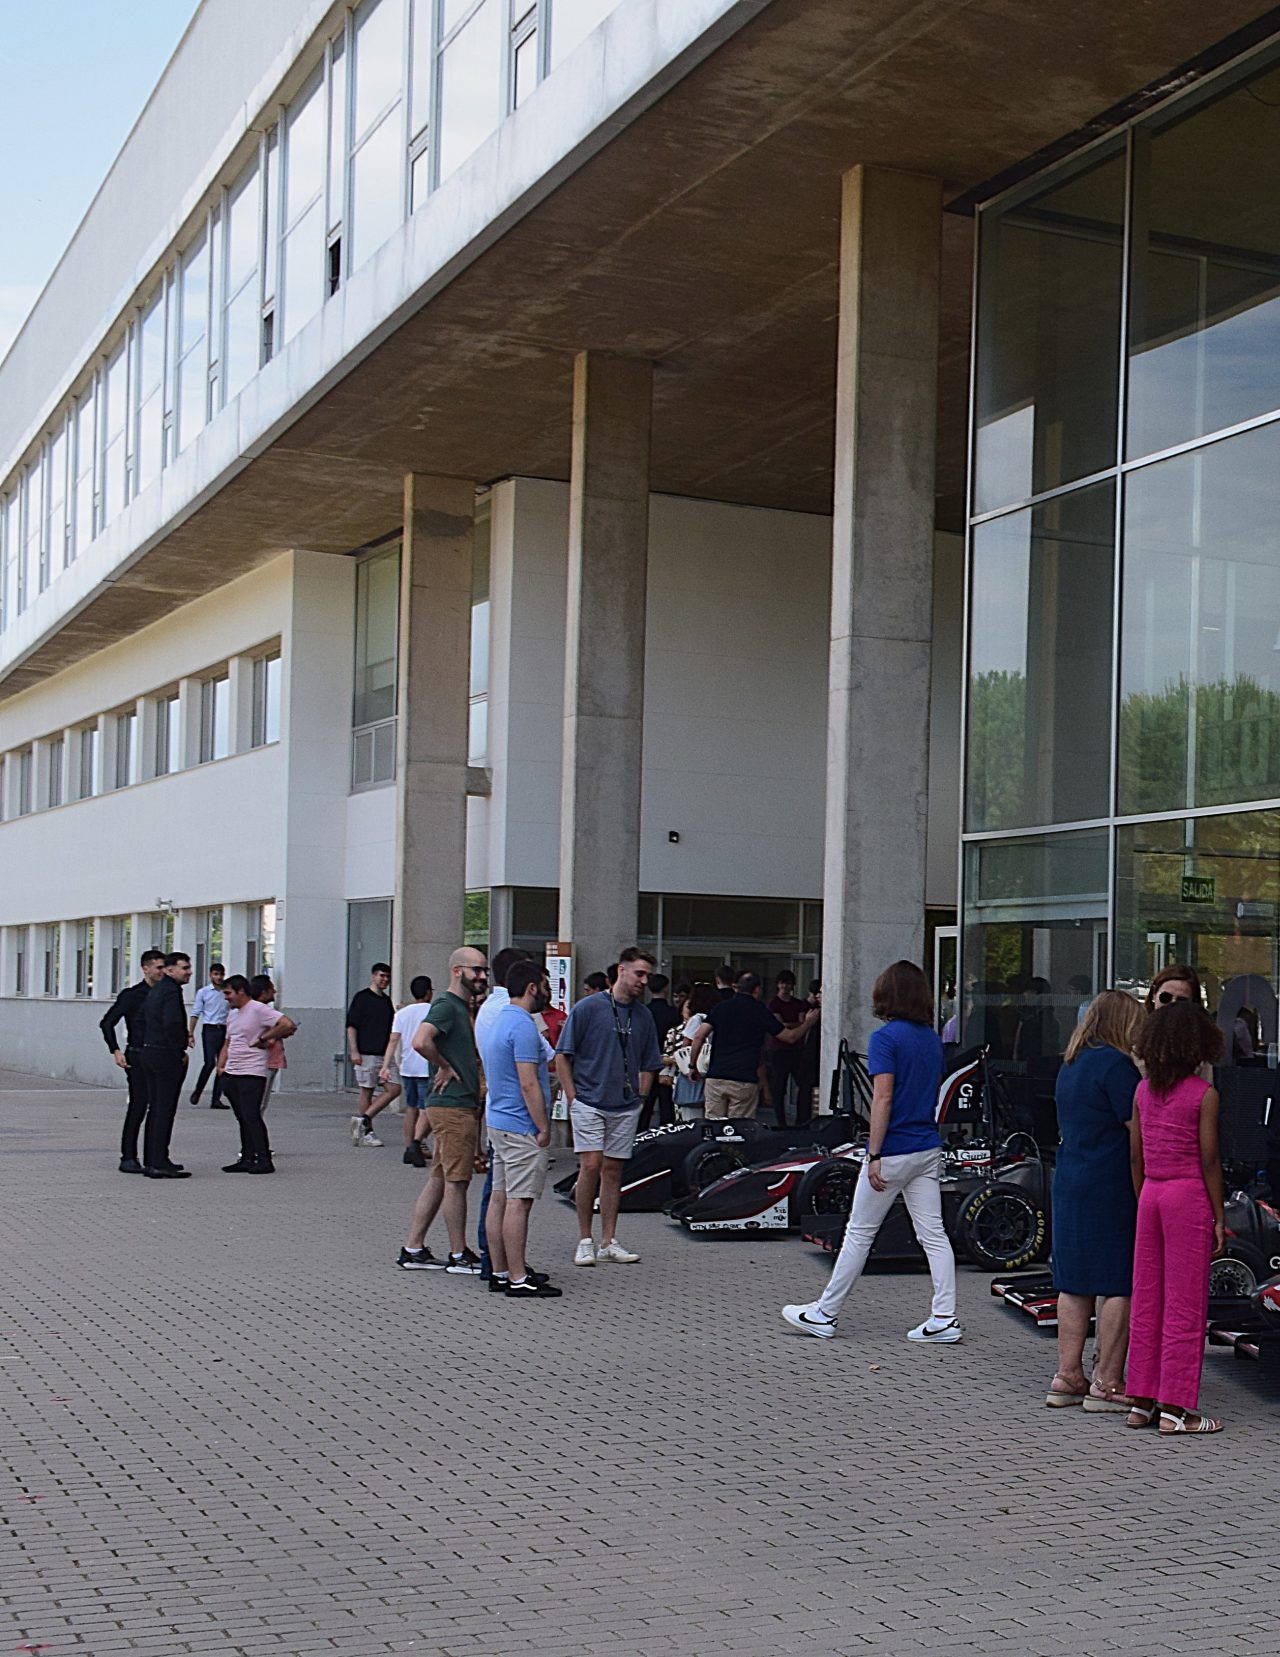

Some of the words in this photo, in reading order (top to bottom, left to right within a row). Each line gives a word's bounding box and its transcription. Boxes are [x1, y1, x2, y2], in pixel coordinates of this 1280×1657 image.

[1182, 881, 1213, 898] SALIDA
[667, 1122, 696, 1133] UPV
[965, 1188, 993, 1222] EAGLE
[1005, 1210, 1046, 1269] GOODYEAR
